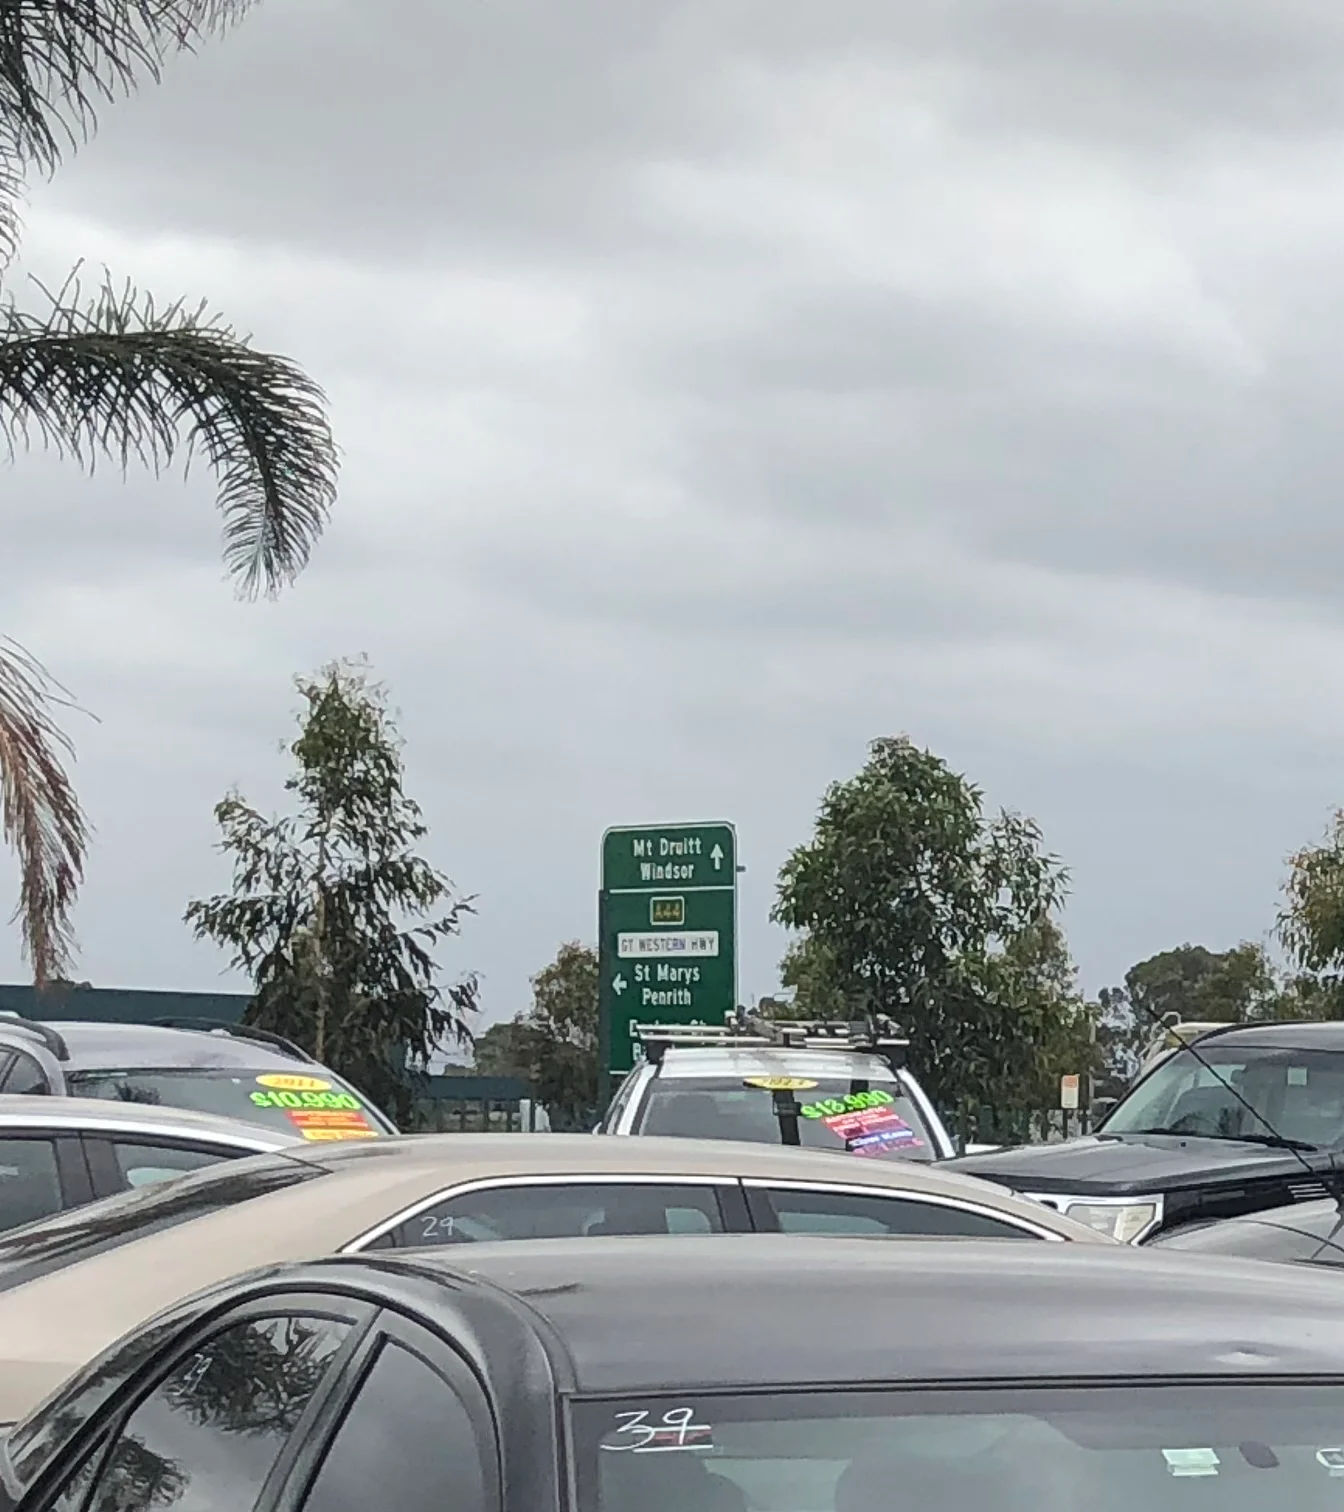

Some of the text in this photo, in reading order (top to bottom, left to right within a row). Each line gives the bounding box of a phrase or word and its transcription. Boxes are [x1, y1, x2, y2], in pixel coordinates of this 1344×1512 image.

[632, 836, 702, 857] Mt Druitt
[640, 861, 695, 881] Windsor
[621, 936, 715, 952] GT WESTERN HWY
[633, 963, 701, 985] St Marys
[641, 987, 692, 1006] Penrith
[248, 1090, 362, 1110] $10.990
[420, 1216, 454, 1237] 29
[599, 1406, 694, 1451] 39
